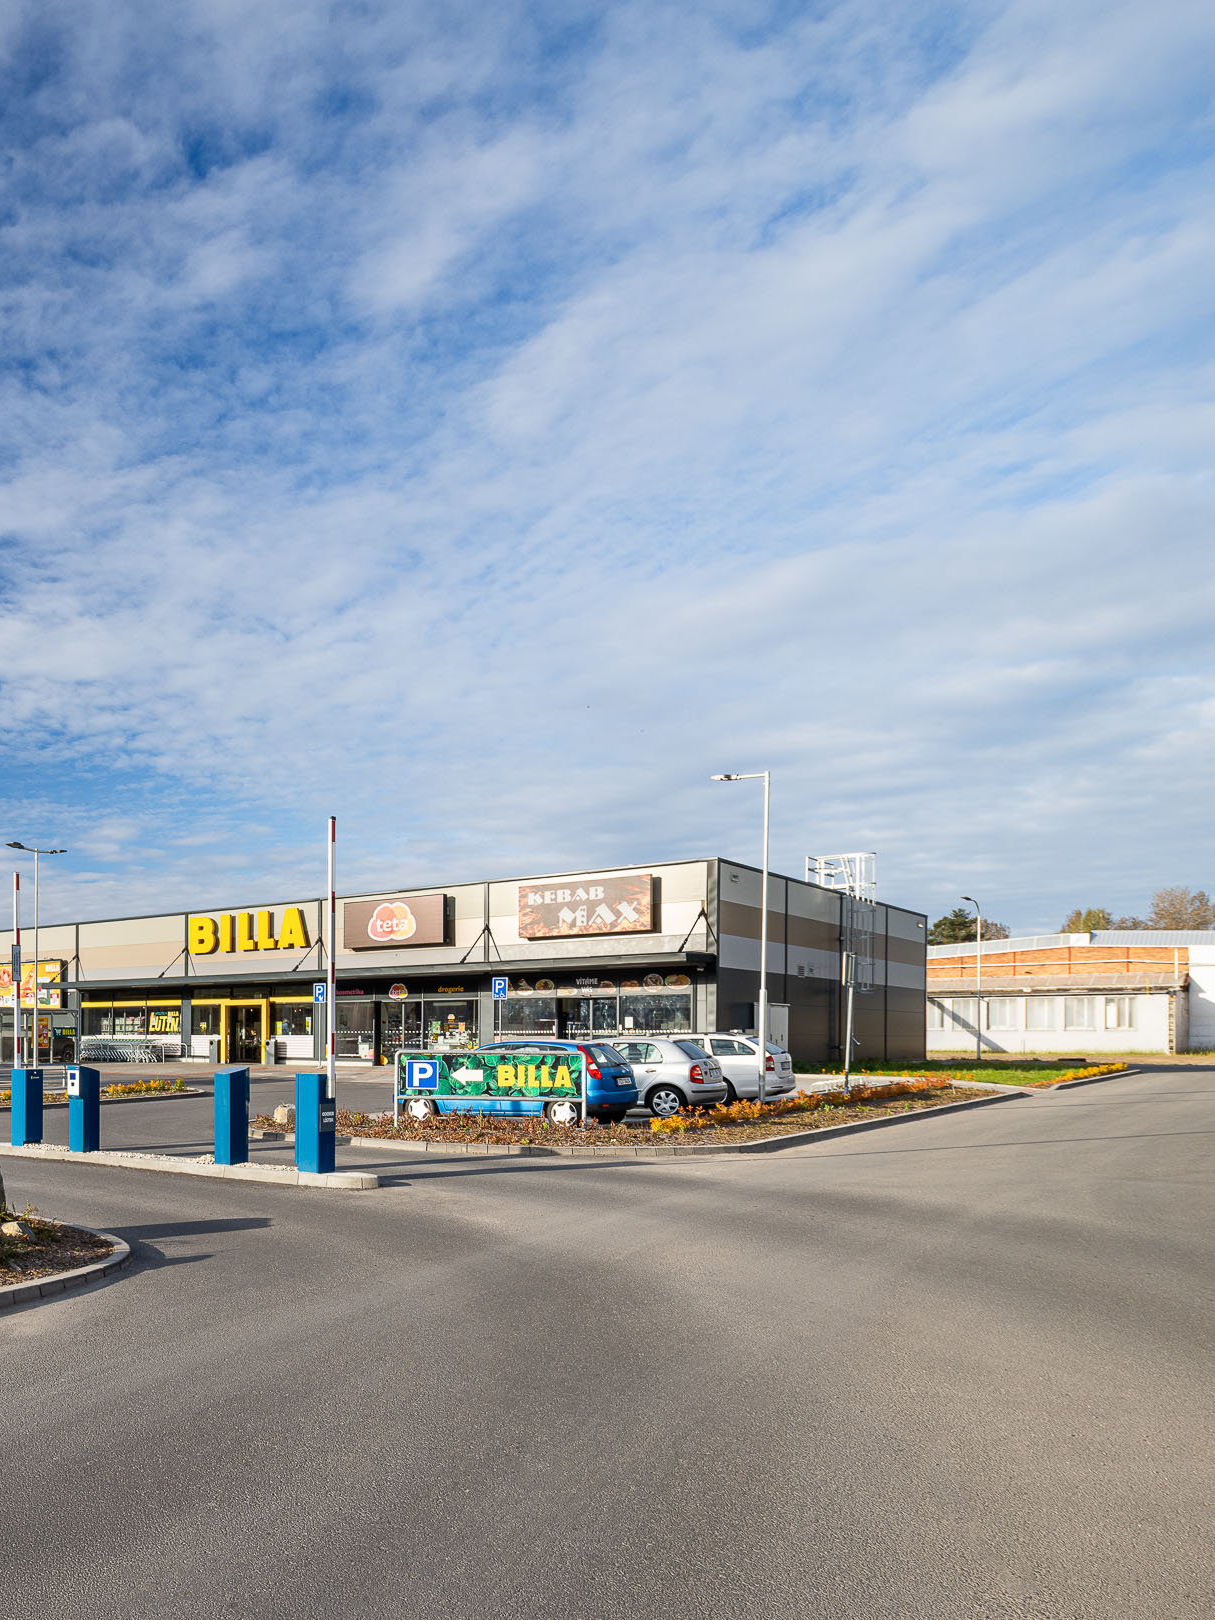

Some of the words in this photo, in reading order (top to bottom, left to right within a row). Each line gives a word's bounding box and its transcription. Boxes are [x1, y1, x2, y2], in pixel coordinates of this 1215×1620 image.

[528, 886, 605, 905] KEBAB
[376, 917, 408, 932] teta
[558, 900, 640, 929] MAX
[189, 908, 308, 955] BILLA
[316, 986, 324, 997] P
[495, 980, 505, 993] P
[412, 1062, 434, 1087] P
[497, 1064, 573, 1088] BILLA
